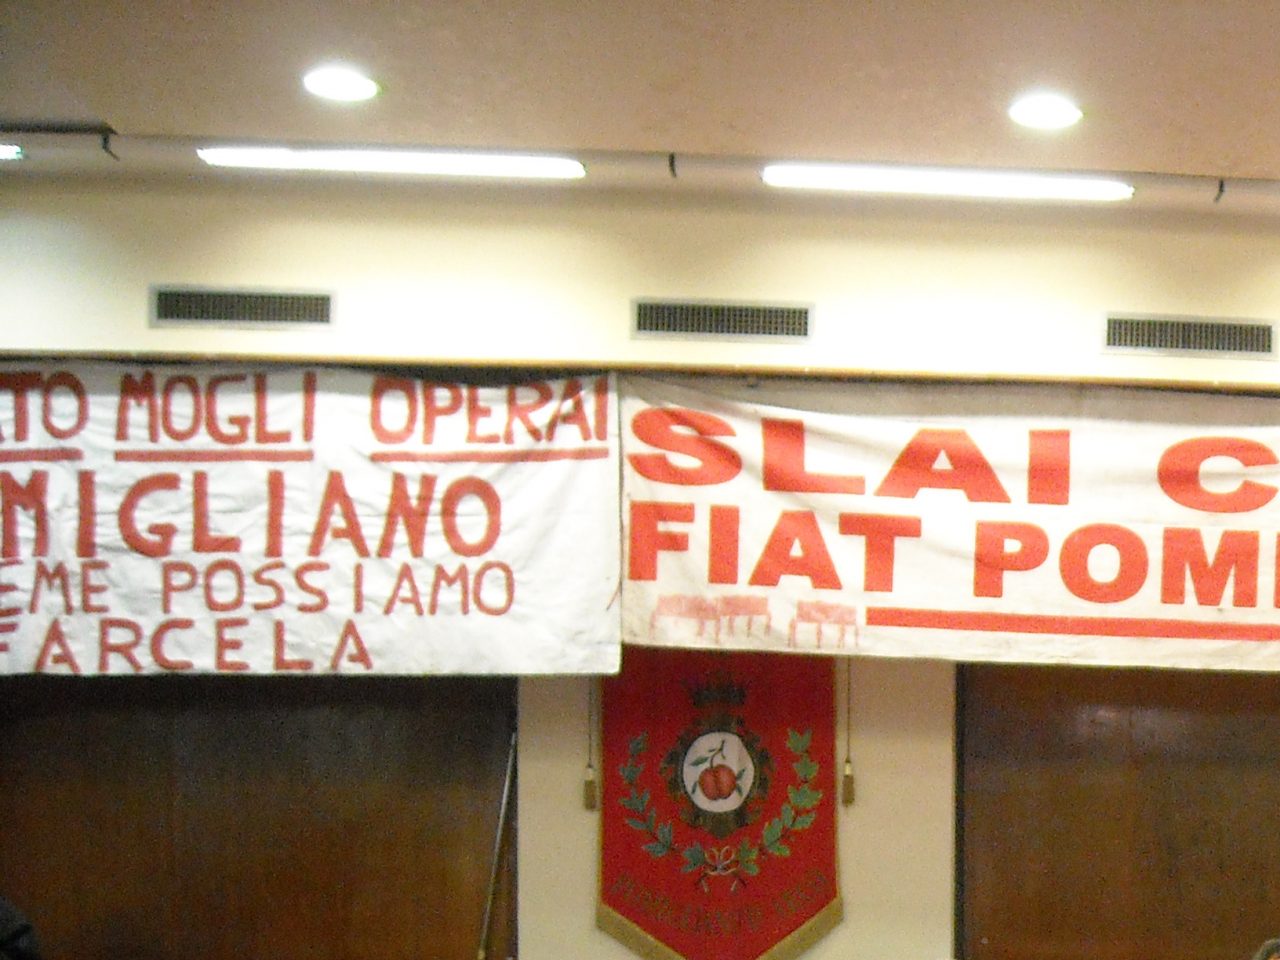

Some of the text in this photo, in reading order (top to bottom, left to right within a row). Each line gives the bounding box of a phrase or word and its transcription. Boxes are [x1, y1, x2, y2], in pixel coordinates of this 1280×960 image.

[0, 370, 609, 445] TO MOGLI OPERAI
[626, 406, 1071, 505] SLAI
[0, 469, 501, 558] MIGLIANO
[627, 500, 922, 593] FIAT
[162, 559, 515, 616] POSSIAMO
